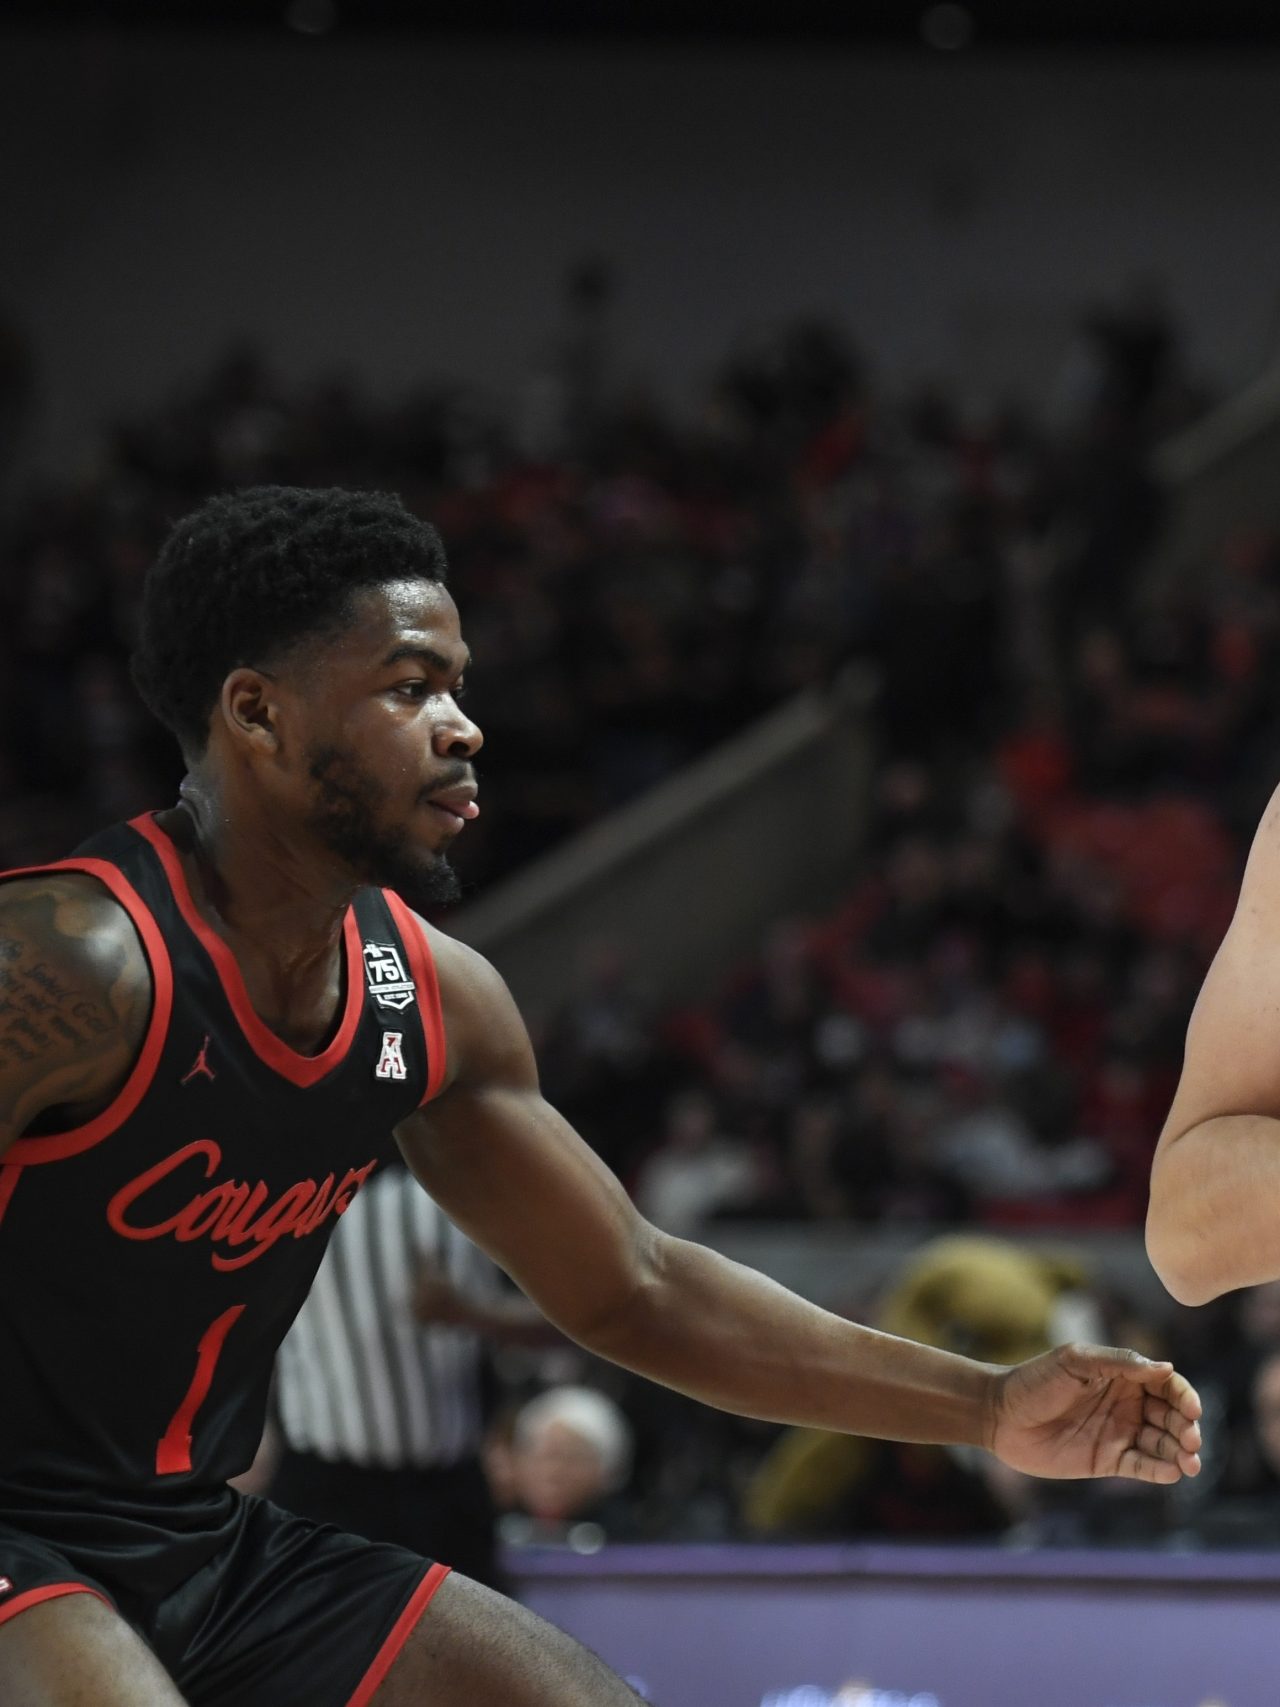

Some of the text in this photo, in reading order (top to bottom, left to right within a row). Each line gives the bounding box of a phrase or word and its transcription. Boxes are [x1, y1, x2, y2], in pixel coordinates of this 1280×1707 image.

[368, 958, 400, 983] 75
[375, 1031, 407, 1080] A
[155, 1304, 248, 1476] 1
